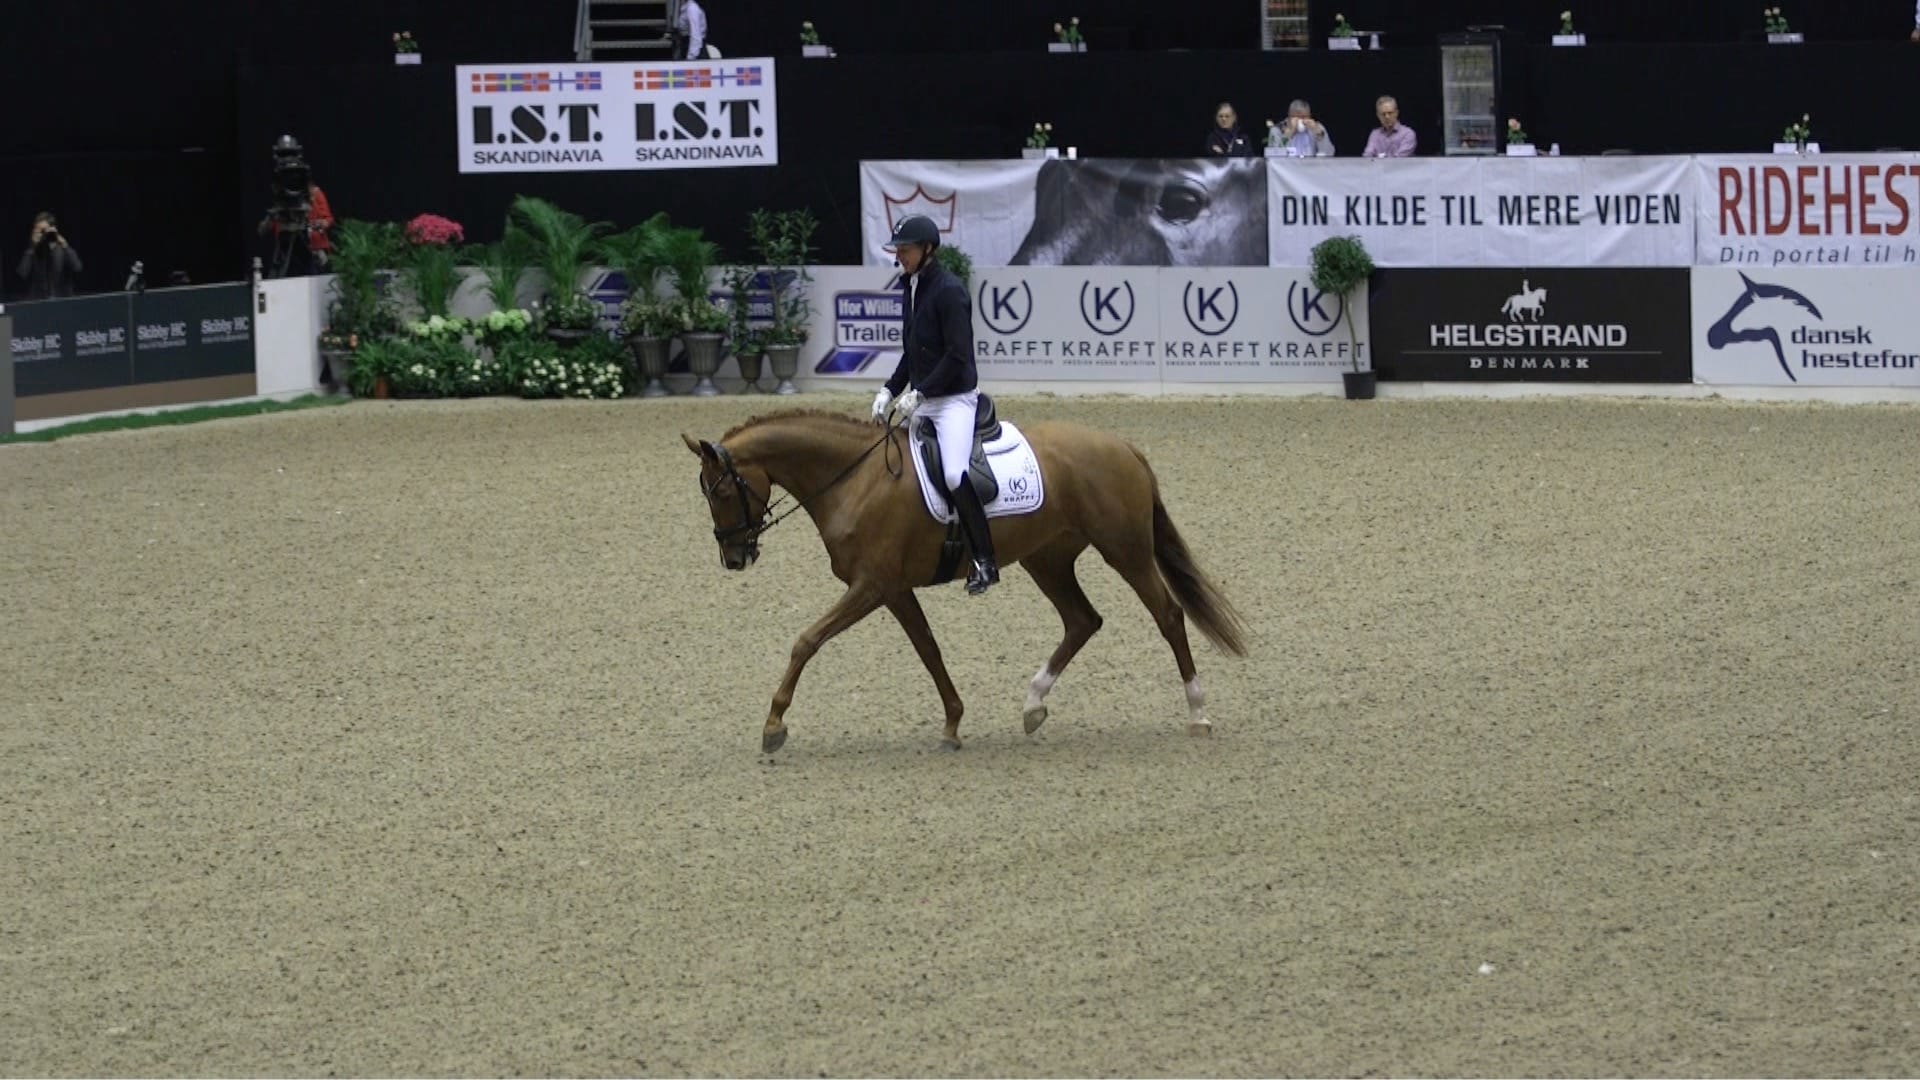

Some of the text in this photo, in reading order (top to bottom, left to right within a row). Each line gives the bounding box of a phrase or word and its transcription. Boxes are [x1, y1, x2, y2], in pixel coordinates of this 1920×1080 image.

[473, 104, 603, 144] I.S.T.
[635, 99, 764, 141] I.S.T.
[473, 149, 603, 164] SKANDINAVIA
[636, 145, 764, 162] SKANDINAVIA
[1282, 194, 1681, 226] DIN KILDE TIL MERE VIDEN
[1720, 245, 1759, 263] Din
[1773, 245, 1849, 267] portal
[1864, 245, 1890, 262] til
[863, 299, 903, 316] Willia
[840, 323, 902, 341] Traile
[1430, 325, 1627, 347] HELGSTRAND
[1791, 326, 1873, 344] dansk
[976, 341, 1053, 356] RAFFT
[1062, 341, 1156, 357] KRAFFT
[1165, 341, 1260, 358] KRAFFT
[1269, 342, 1365, 358] KRAFFT
[1470, 358, 1589, 369] DENMARK
[1802, 349, 1920, 368] hestefor
